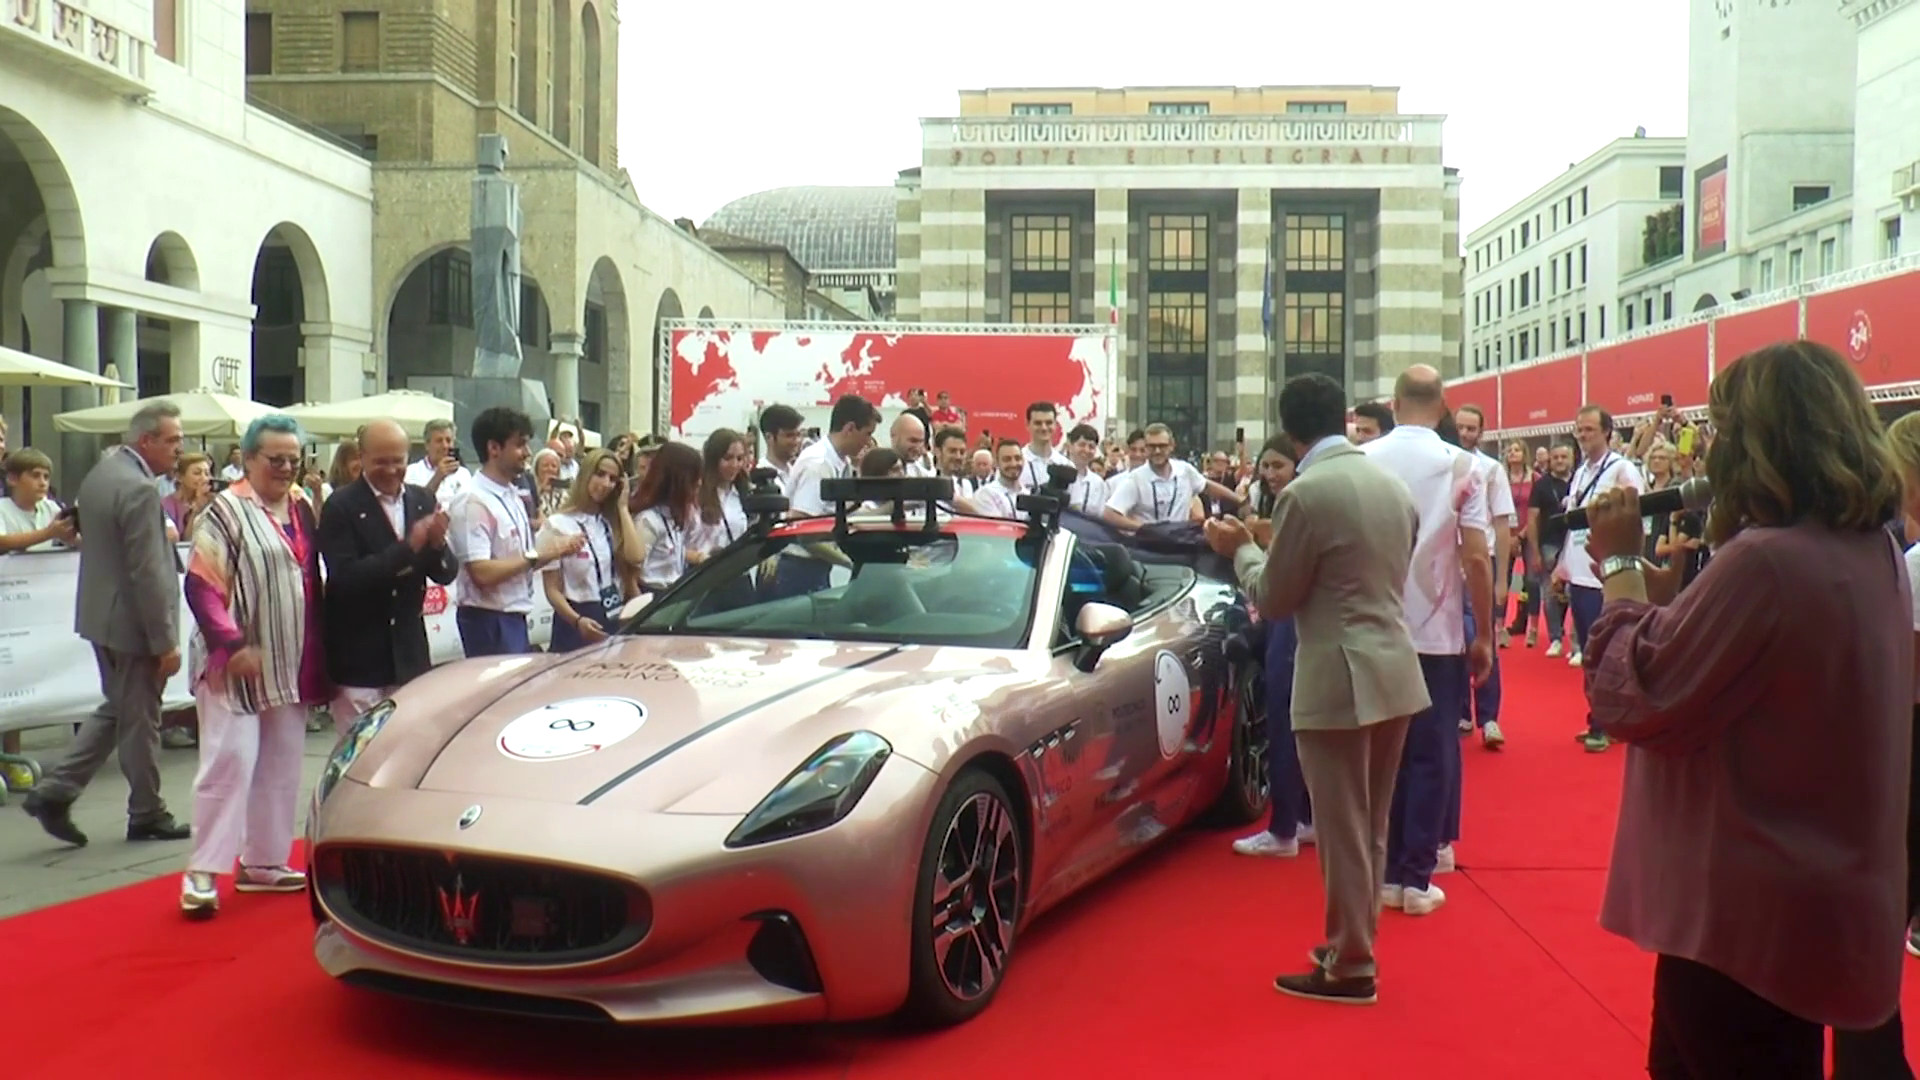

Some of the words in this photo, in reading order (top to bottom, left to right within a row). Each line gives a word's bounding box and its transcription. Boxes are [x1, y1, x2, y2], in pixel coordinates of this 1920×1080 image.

[951, 150, 1075, 165] POSTE
[1127, 150, 1136, 165] E
[1187, 148, 1412, 164] TELEGRAFI
